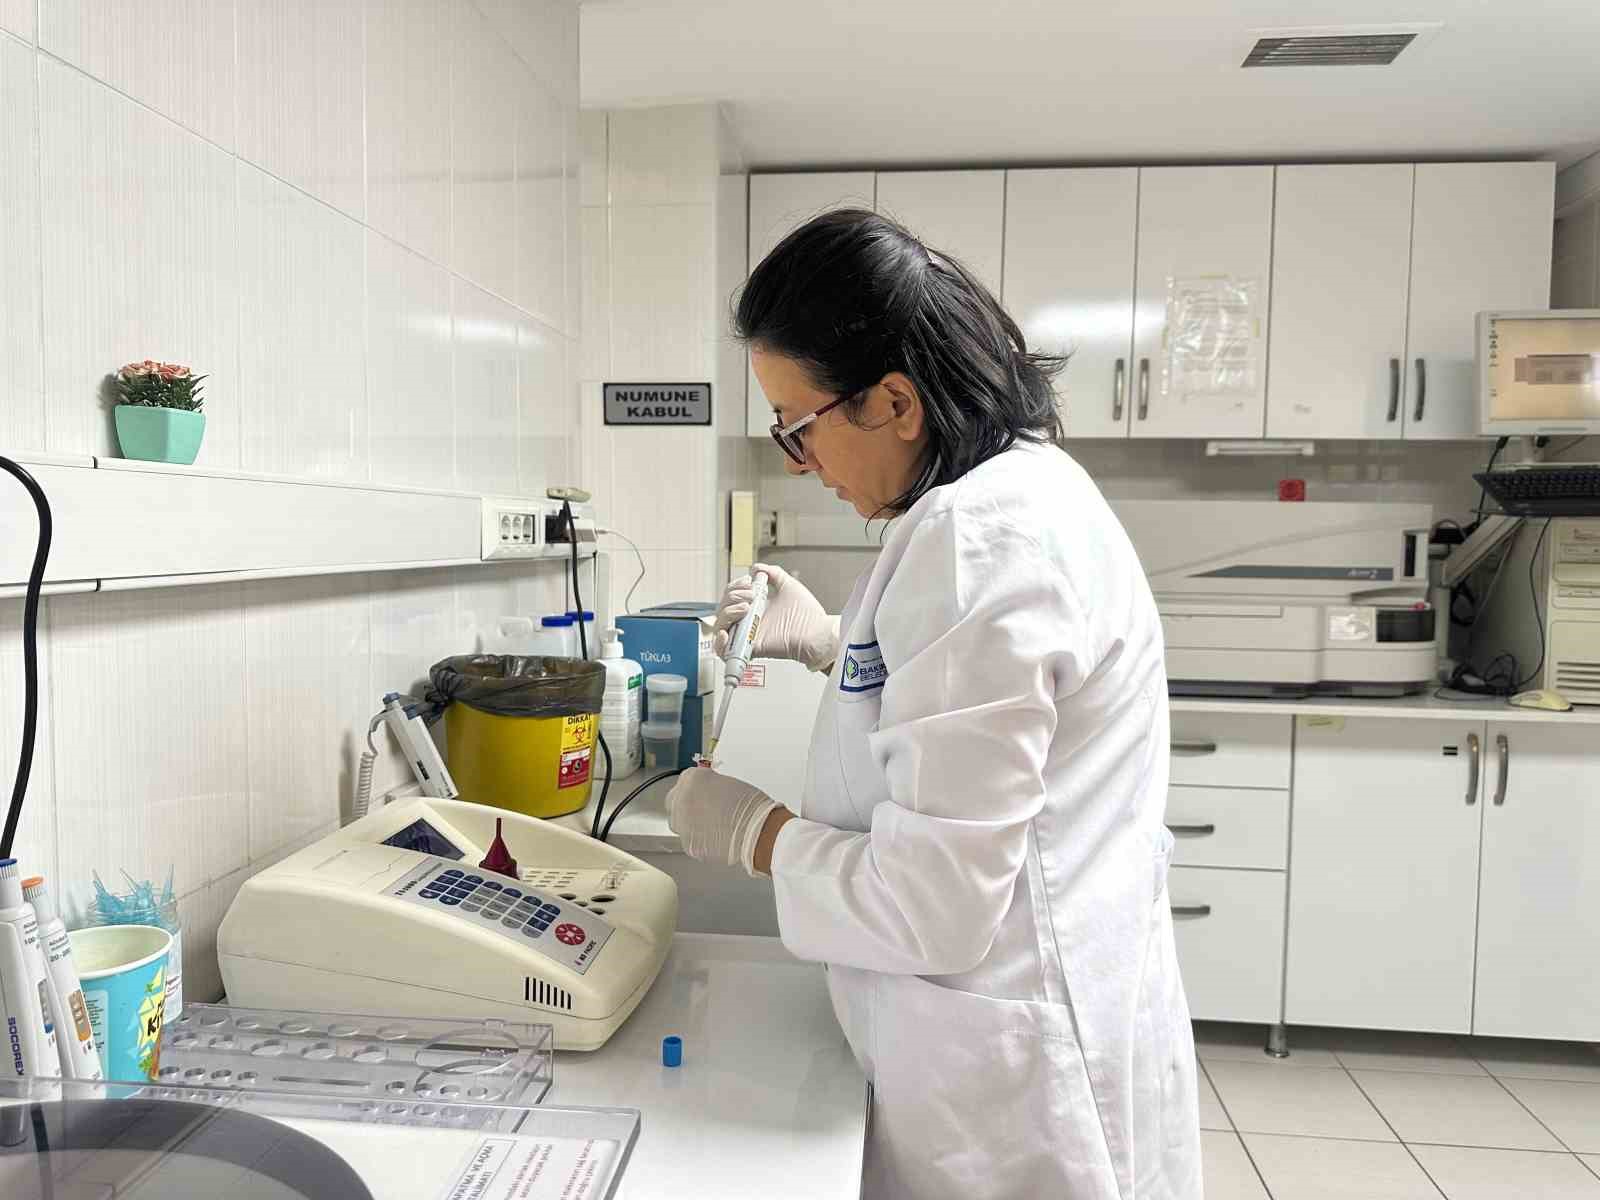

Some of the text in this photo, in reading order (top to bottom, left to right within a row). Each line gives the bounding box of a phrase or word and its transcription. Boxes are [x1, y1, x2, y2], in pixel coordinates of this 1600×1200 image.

[615, 391, 700, 401] NUMUNE
[627, 406, 693, 417] KABUL
[7, 1016, 25, 1076] SOCOREX
